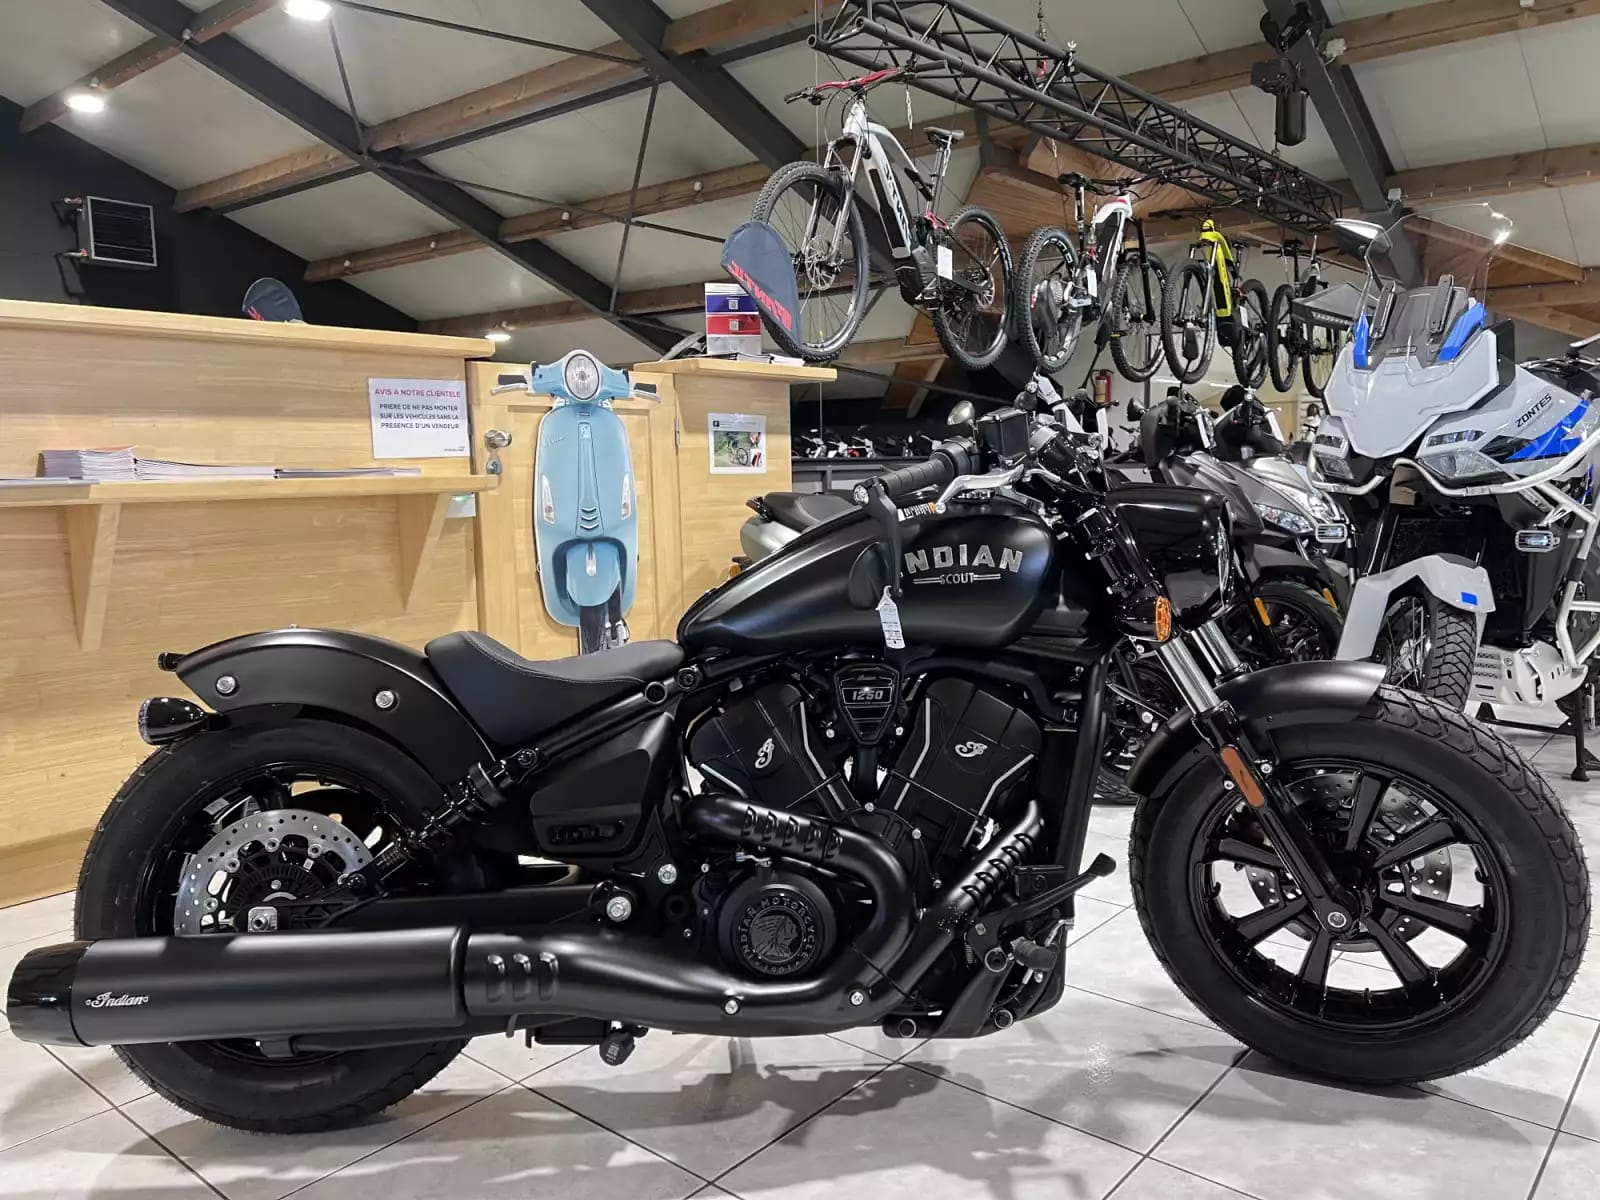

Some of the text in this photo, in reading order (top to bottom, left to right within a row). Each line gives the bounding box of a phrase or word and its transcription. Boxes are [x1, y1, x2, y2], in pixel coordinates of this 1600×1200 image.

[375, 388, 392, 396] AVIS
[401, 389, 425, 397] NOTRE
[1514, 392, 1553, 428] ZONTES
[903, 544, 1023, 574] NDIAN
[939, 572, 975, 585] SCOUT
[852, 690, 884, 701] 1250
[87, 991, 147, 1008] Indian
